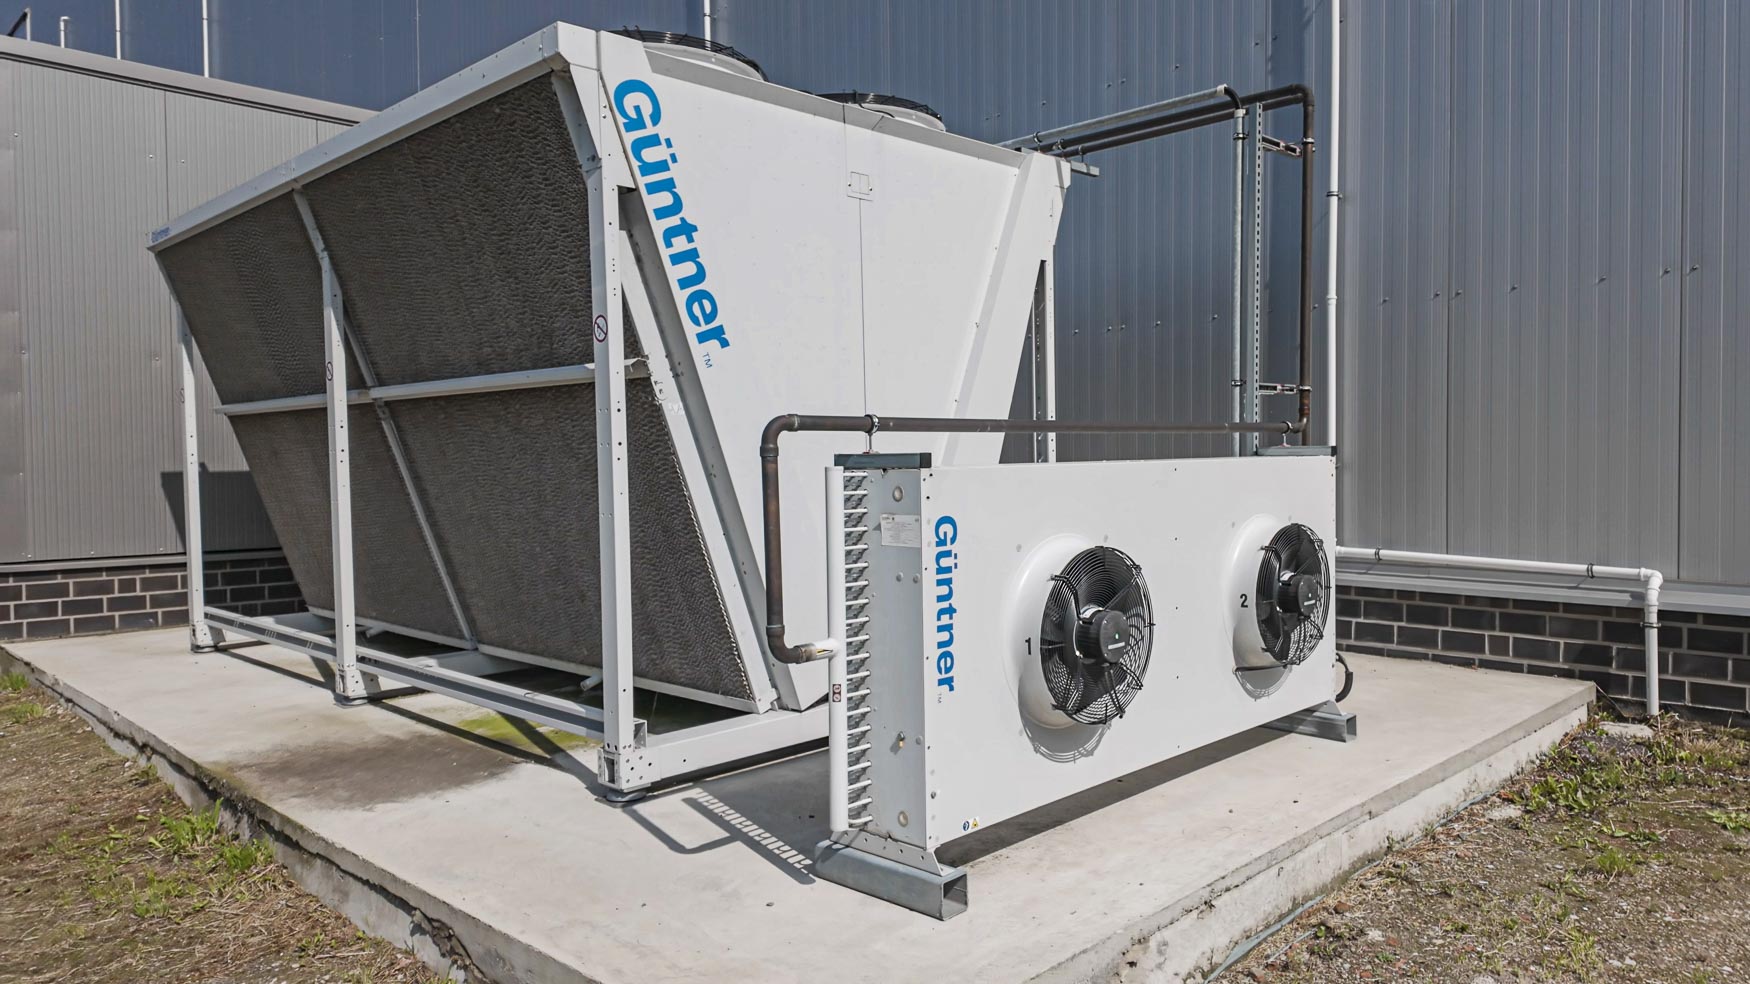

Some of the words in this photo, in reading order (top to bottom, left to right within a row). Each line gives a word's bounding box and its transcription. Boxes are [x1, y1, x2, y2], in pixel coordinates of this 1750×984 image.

[613, 79, 730, 349] Güntner
[934, 515, 958, 692] Güntner
[1025, 637, 1031, 655] 1
[1240, 593, 1248, 608] 2
